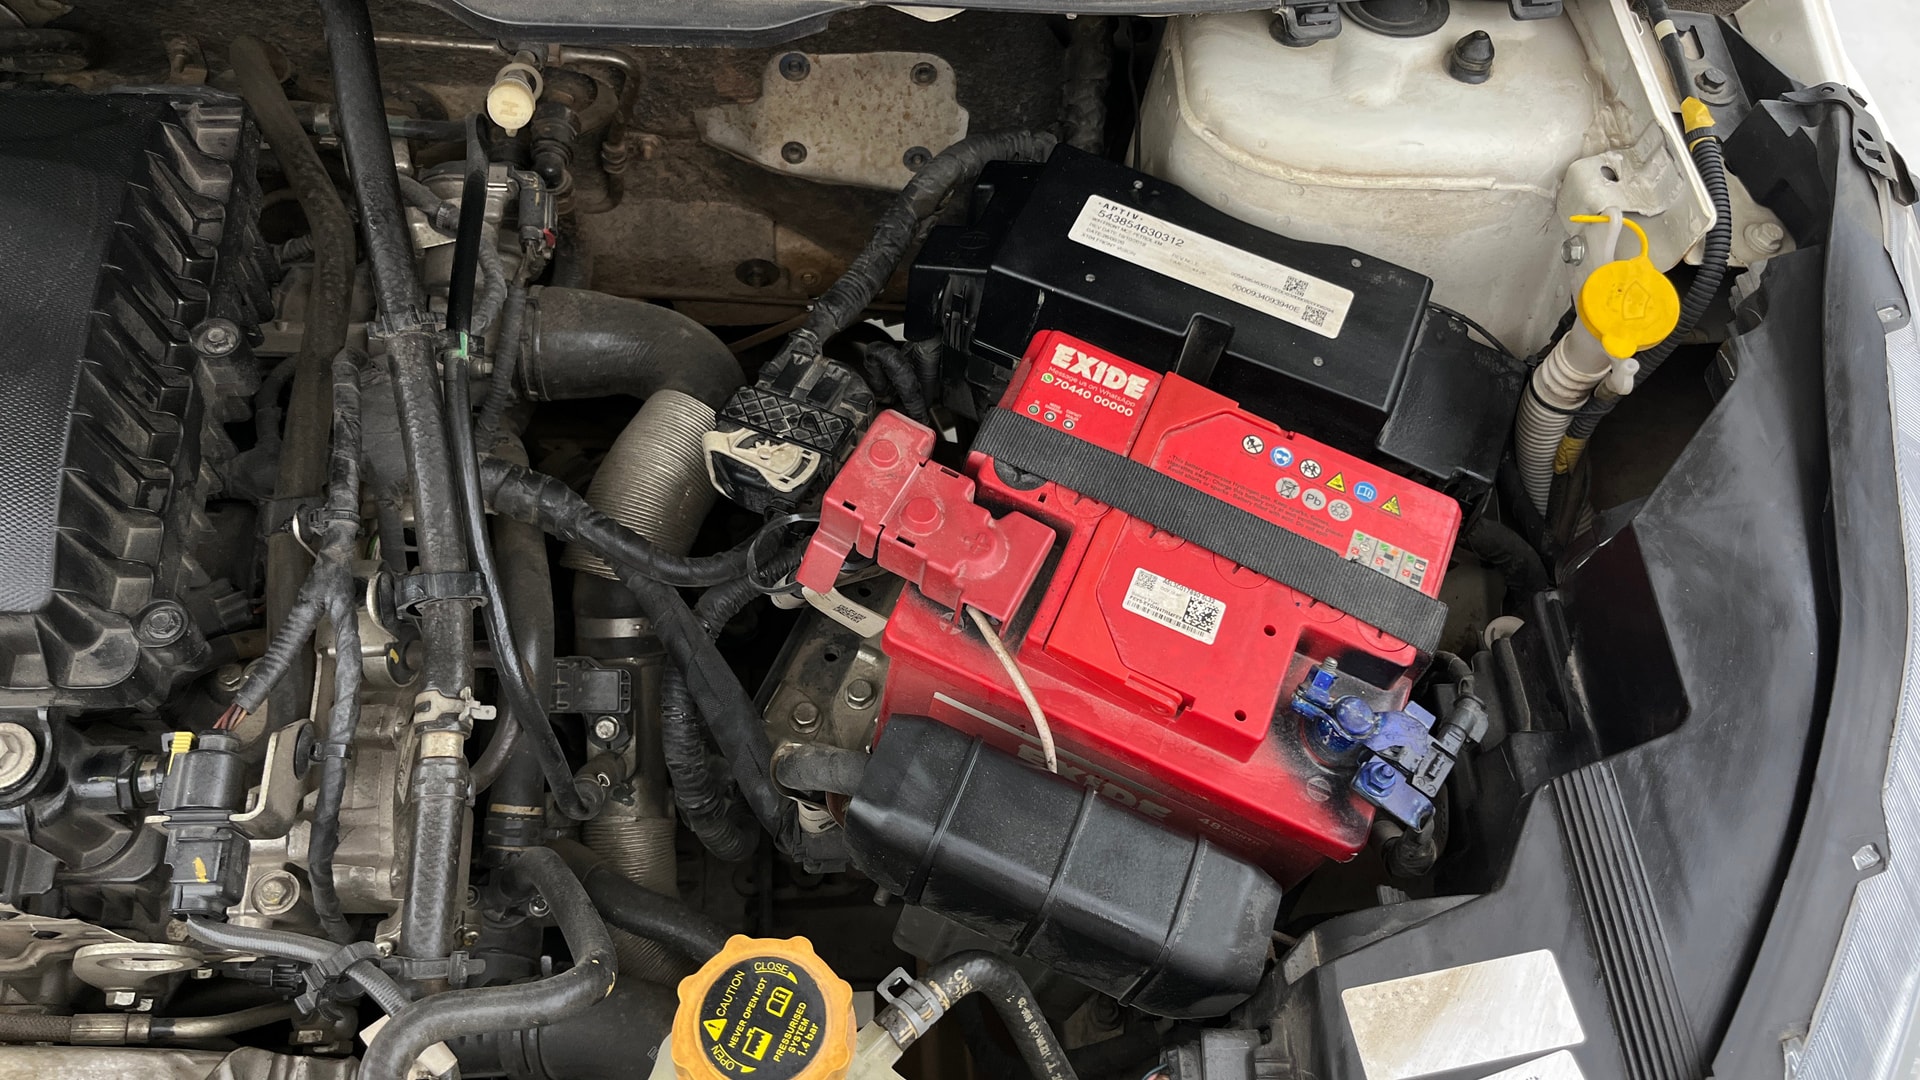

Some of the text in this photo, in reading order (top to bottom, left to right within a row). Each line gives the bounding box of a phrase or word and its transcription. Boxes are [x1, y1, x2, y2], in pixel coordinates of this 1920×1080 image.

[1097, 209, 1183, 247] 543854630312
[1102, 203, 1138, 219] APTIV
[1048, 366, 1077, 382] Message
[1099, 388, 1135, 406] WhatsApp
[1050, 342, 1148, 399] EXIDE
[1054, 378, 1133, 416] 70440 00000
[1168, 466, 1183, 475] Avoid
[1185, 473, 1201, 483] shorts
[1210, 485, 1228, 495] sparks
[1232, 493, 1252, 505] Battery
[1172, 455, 1183, 463] This
[1184, 461, 1202, 473] battery
[1205, 470, 1230, 483] generates
[1233, 481, 1258, 496] Hydrogen
[1212, 479, 1231, 491] Charge
[1245, 493, 1262, 504] battery
[1306, 493, 1321, 505] Pb
[1197, 816, 1220, 830] 48
[754, 962, 789, 975] CLOSE
[716, 970, 746, 1017] CAUTION
[728, 977, 768, 1049] NEVER OPEN HOT
[773, 1002, 807, 1062] PRESSURISED
[788, 1018, 810, 1054] SYSTEM
[798, 1023, 819, 1056] 1.4 bar
[711, 1045, 735, 1071] OPEN
